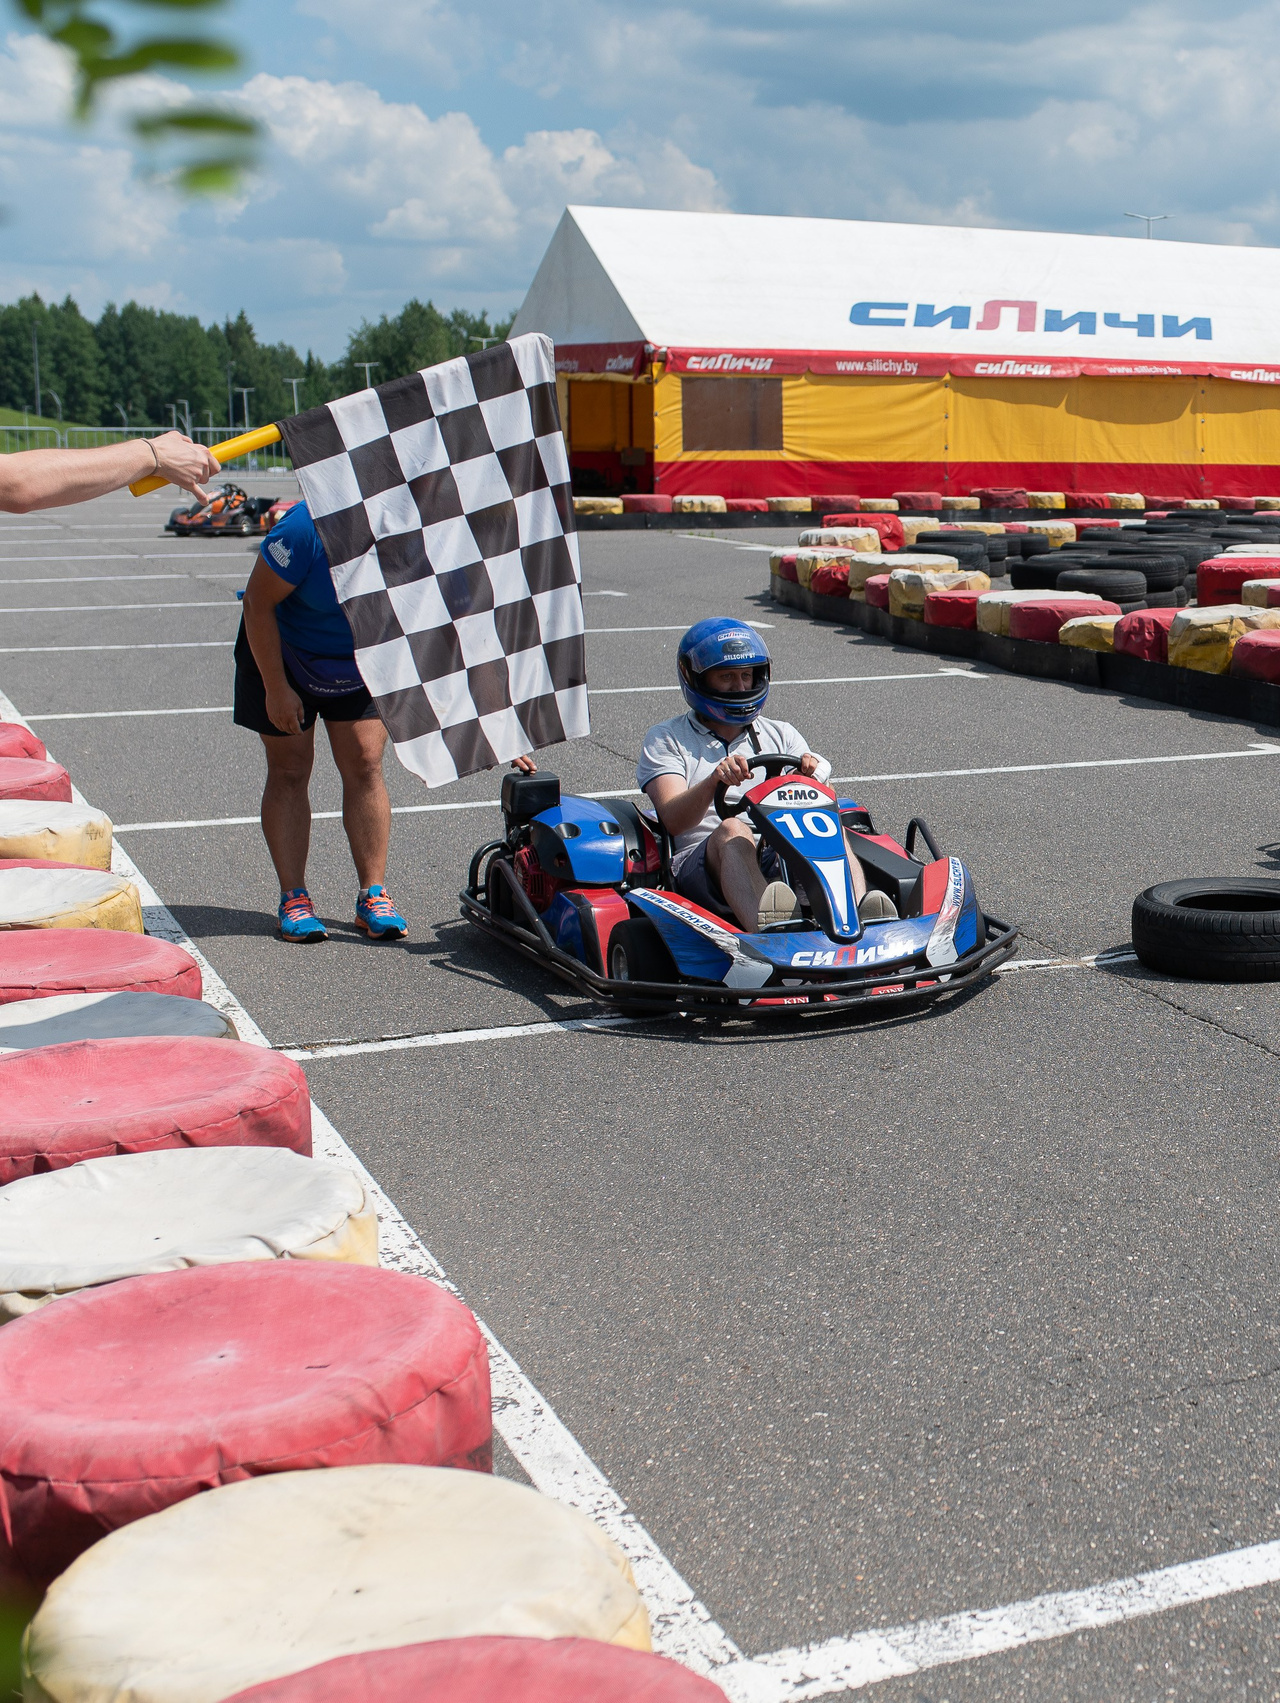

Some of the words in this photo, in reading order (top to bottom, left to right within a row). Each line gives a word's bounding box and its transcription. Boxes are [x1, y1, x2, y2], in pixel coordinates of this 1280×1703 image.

[835, 358, 919, 375] www.silichy.by
[1105, 364, 1183, 375] www.silichy.by
[775, 811, 838, 839] 10
[640, 891, 717, 933] WWW.SILICHY.BY
